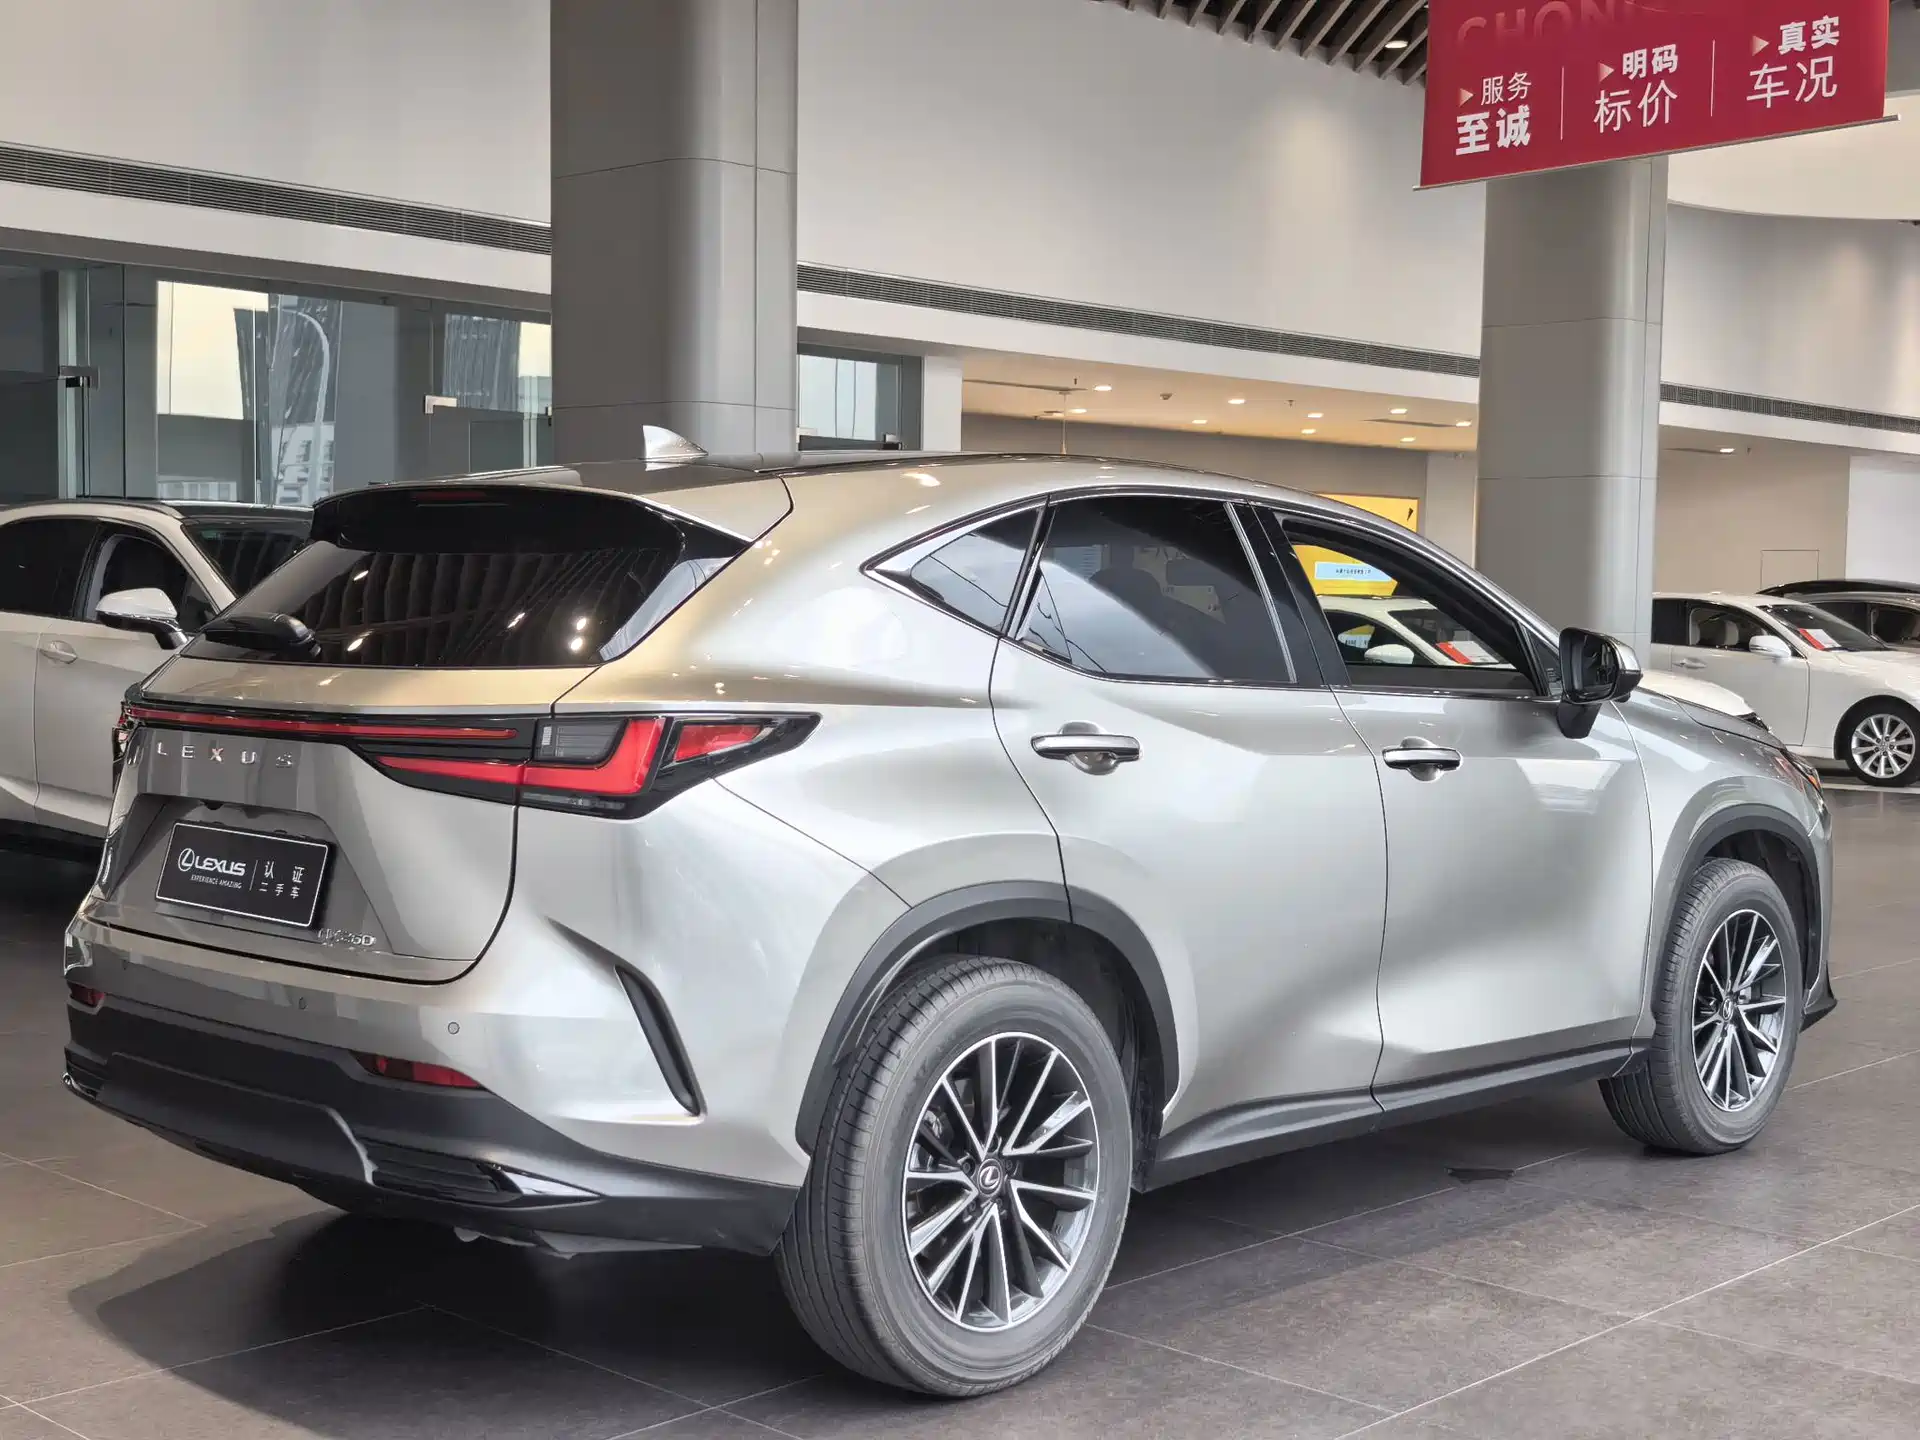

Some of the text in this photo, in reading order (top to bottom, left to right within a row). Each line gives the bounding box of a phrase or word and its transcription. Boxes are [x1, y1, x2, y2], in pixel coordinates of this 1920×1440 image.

[1778, 15, 1841, 55] 真实
[1622, 43, 1679, 80] 明码
[1480, 72, 1532, 106] 服务
[1746, 56, 1838, 109] 车况
[1594, 79, 1679, 134] 标价
[1455, 105, 1532, 156] 至诚
[157, 742, 293, 768] LEXUS
[194, 855, 247, 876] LEXUS
